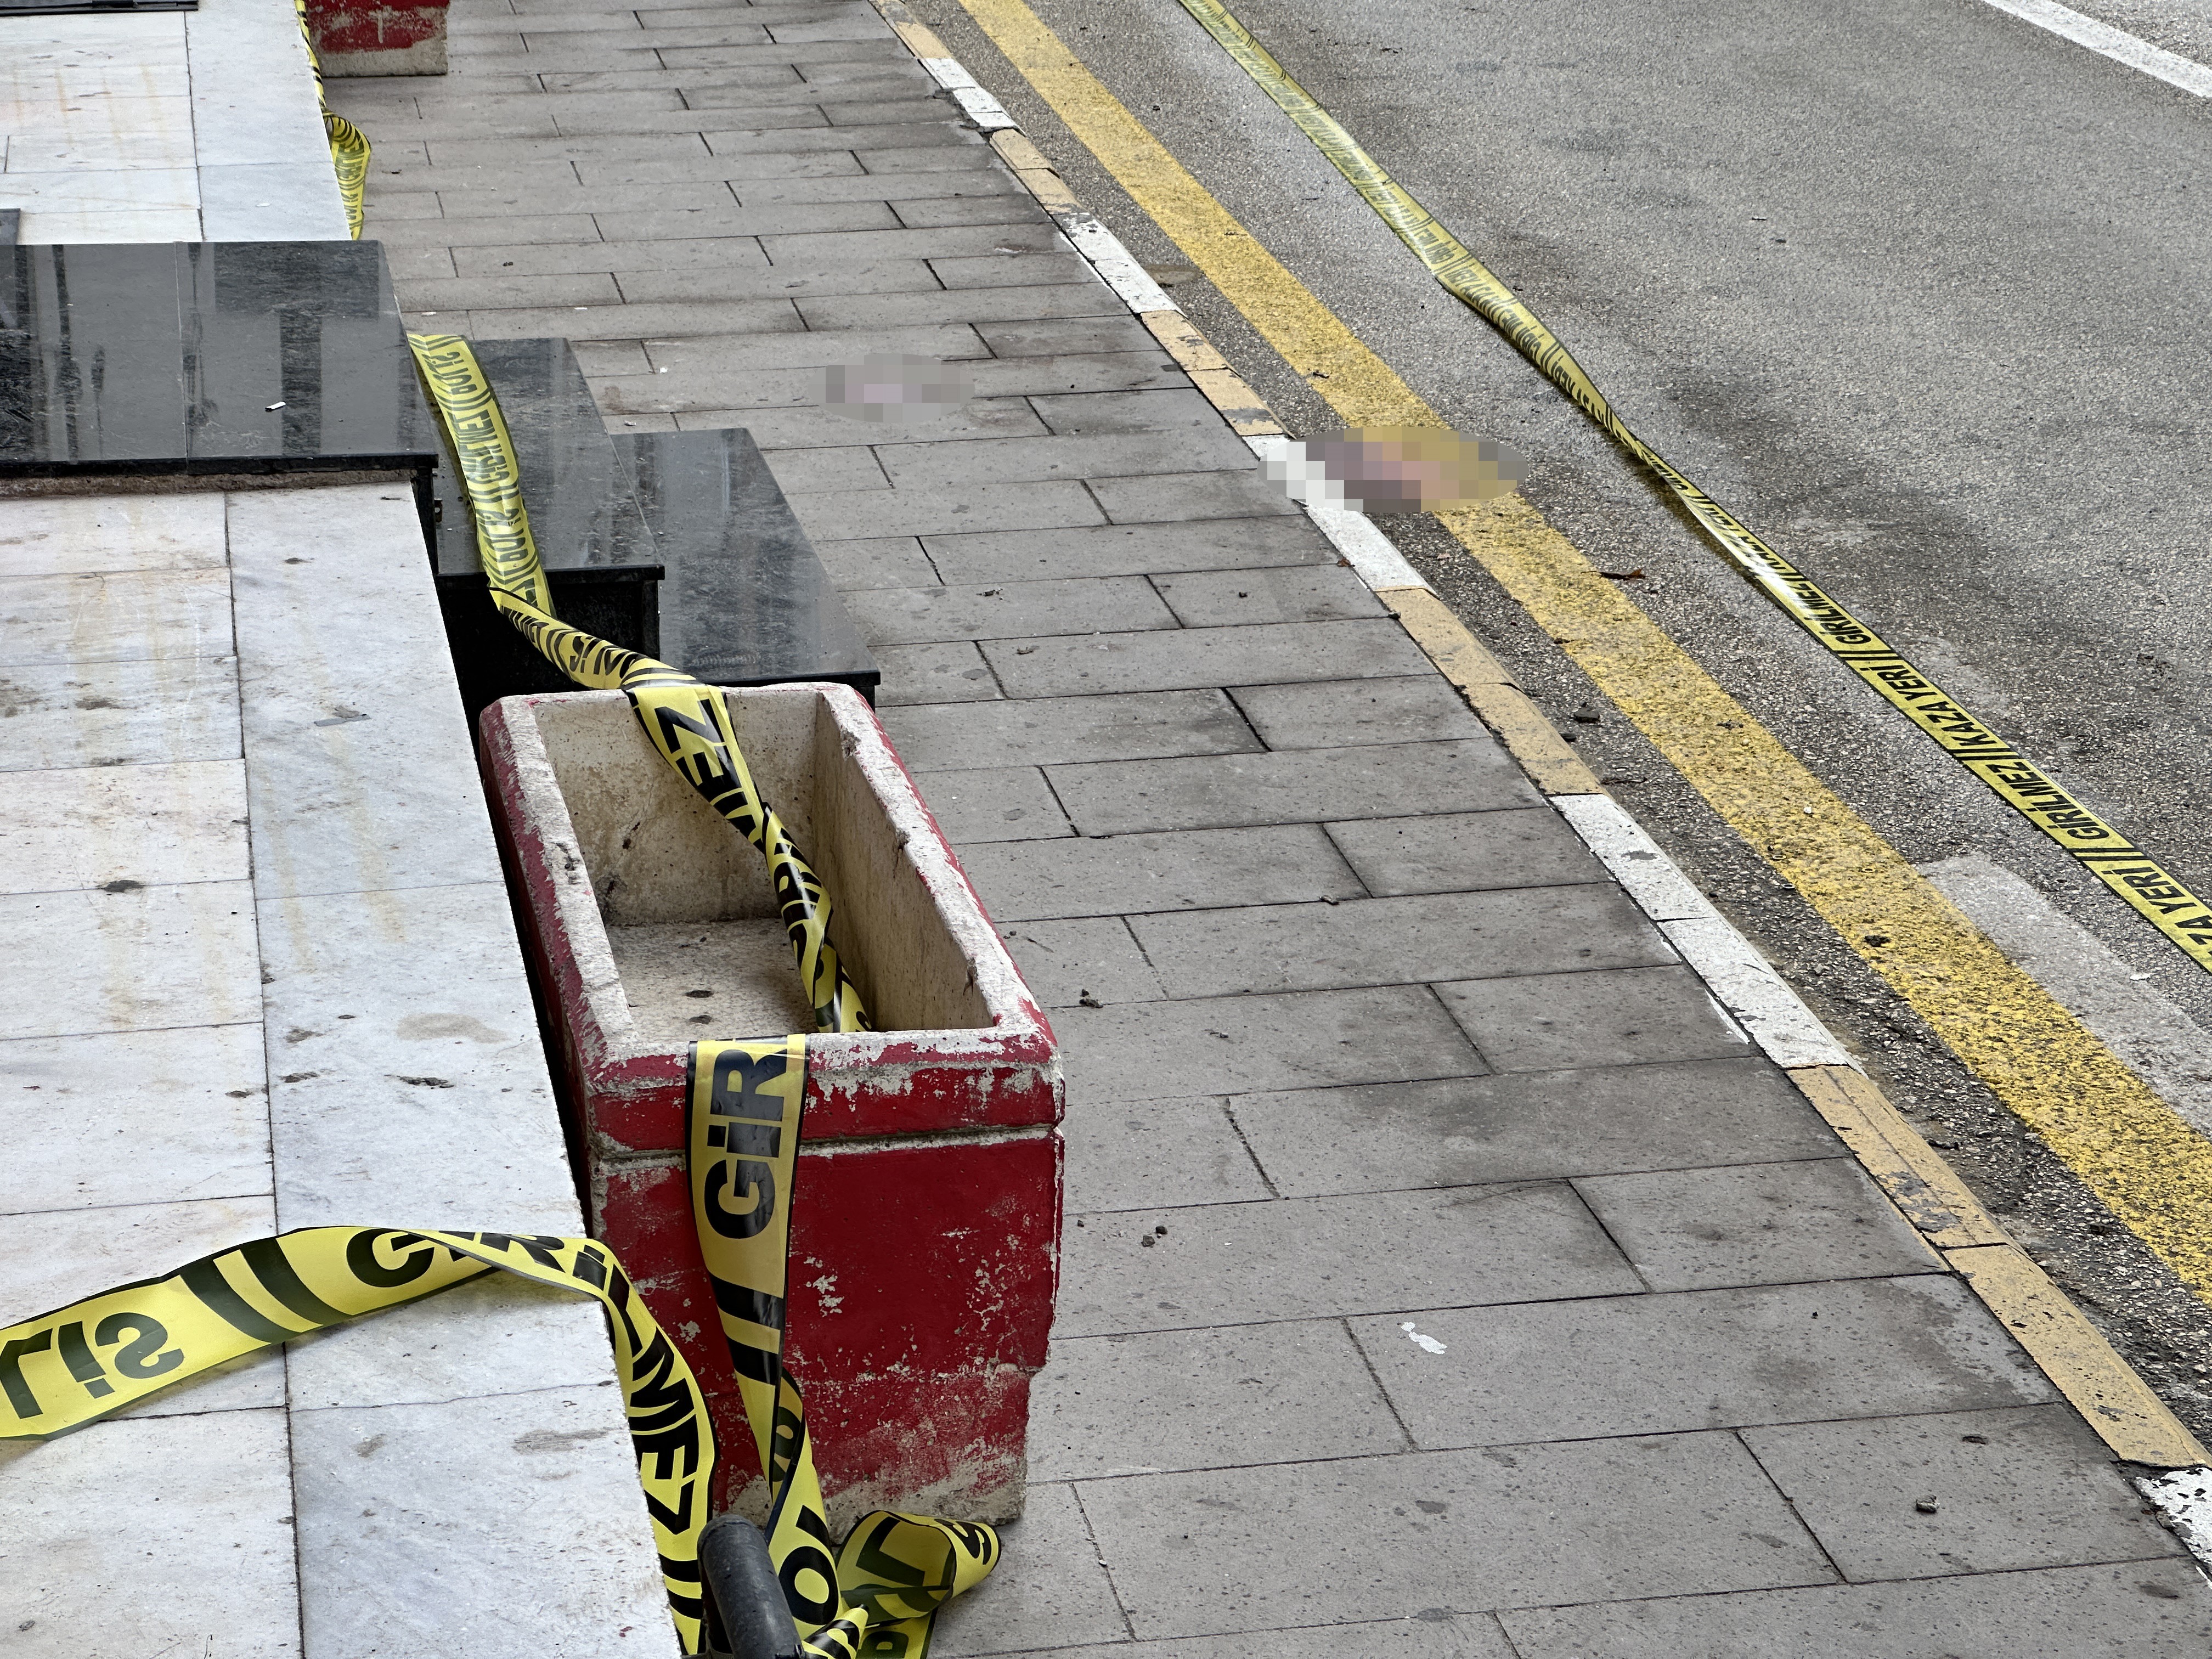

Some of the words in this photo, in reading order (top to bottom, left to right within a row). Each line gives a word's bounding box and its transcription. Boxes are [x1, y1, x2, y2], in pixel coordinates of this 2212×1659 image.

[1864, 665, 1938, 701] YERİ
[1917, 701, 1996, 746] KAZA
[1988, 761, 2110, 840] GİRİLMEZ
[2102, 867, 2198, 915] YERİ
